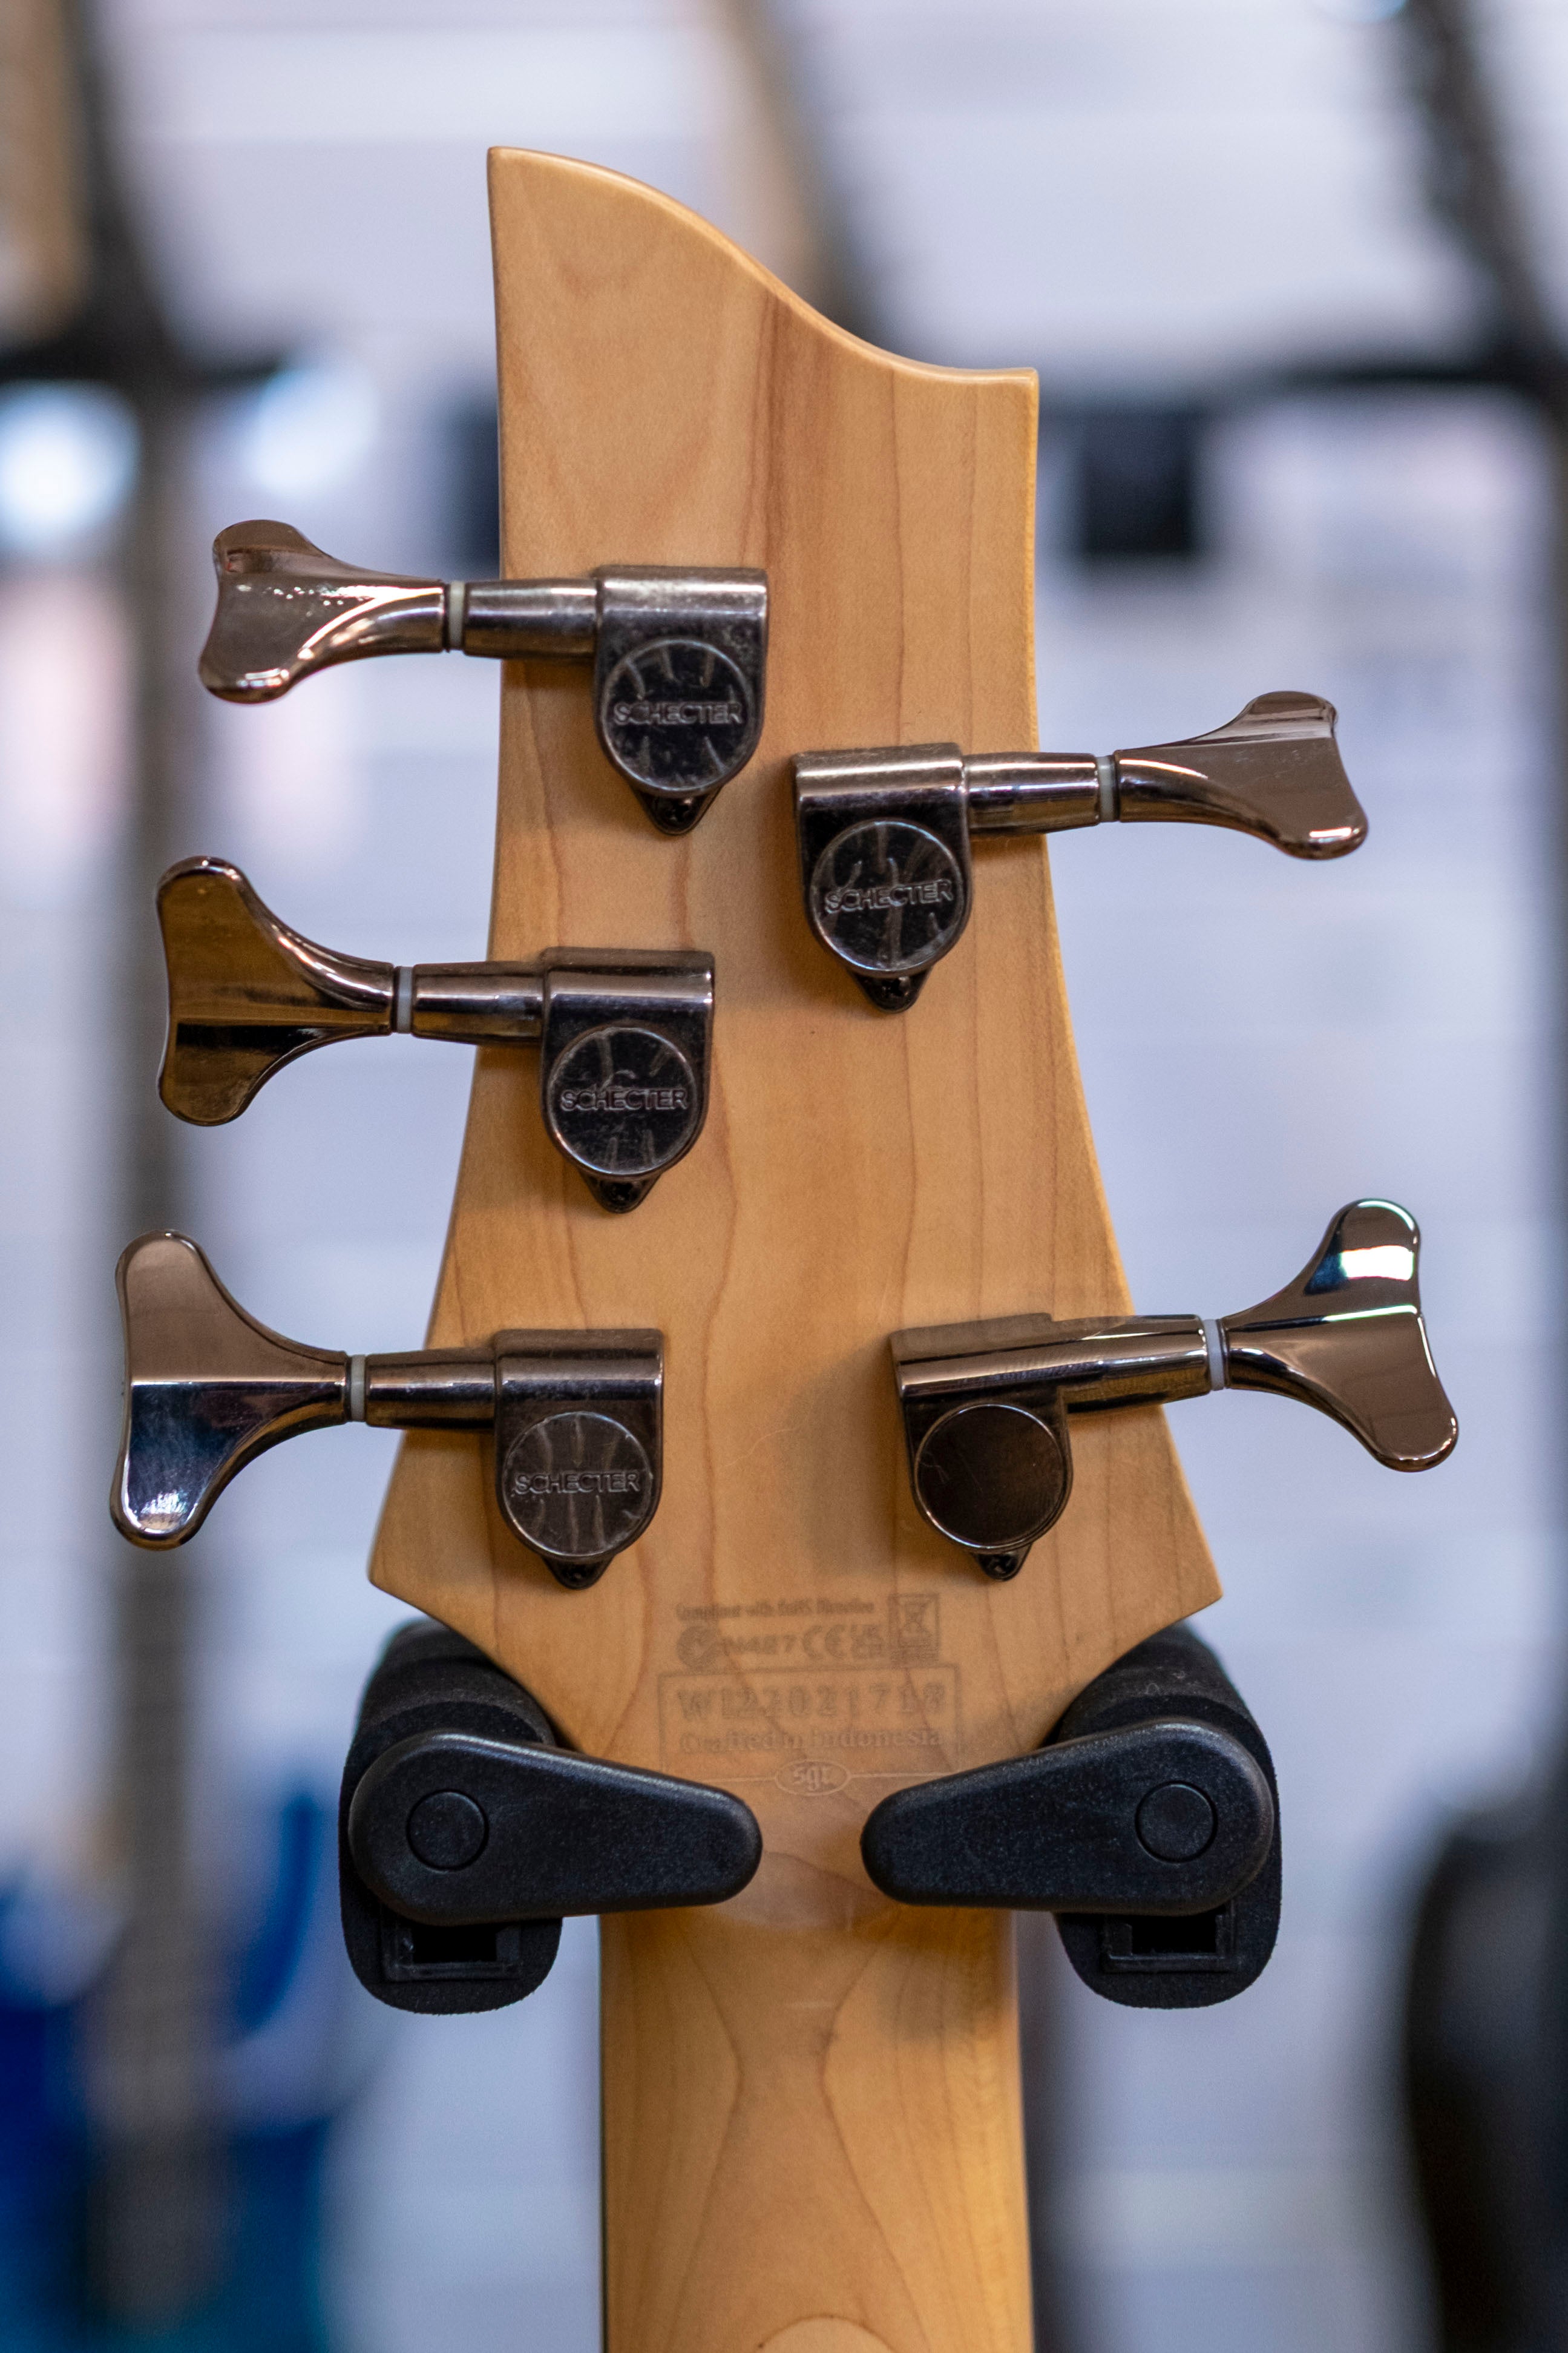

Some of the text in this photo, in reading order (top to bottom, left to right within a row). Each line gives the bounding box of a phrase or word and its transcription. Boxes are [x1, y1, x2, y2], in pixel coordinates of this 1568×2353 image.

[612, 701, 744, 725] SCHECTER
[824, 879, 954, 914] SCHECTER
[560, 1088, 688, 1112] SCHECTER
[514, 1470, 640, 1495] SCHECTER
[679, 1728, 778, 1754] Crafted
[810, 1726, 943, 1749] Indonesia
